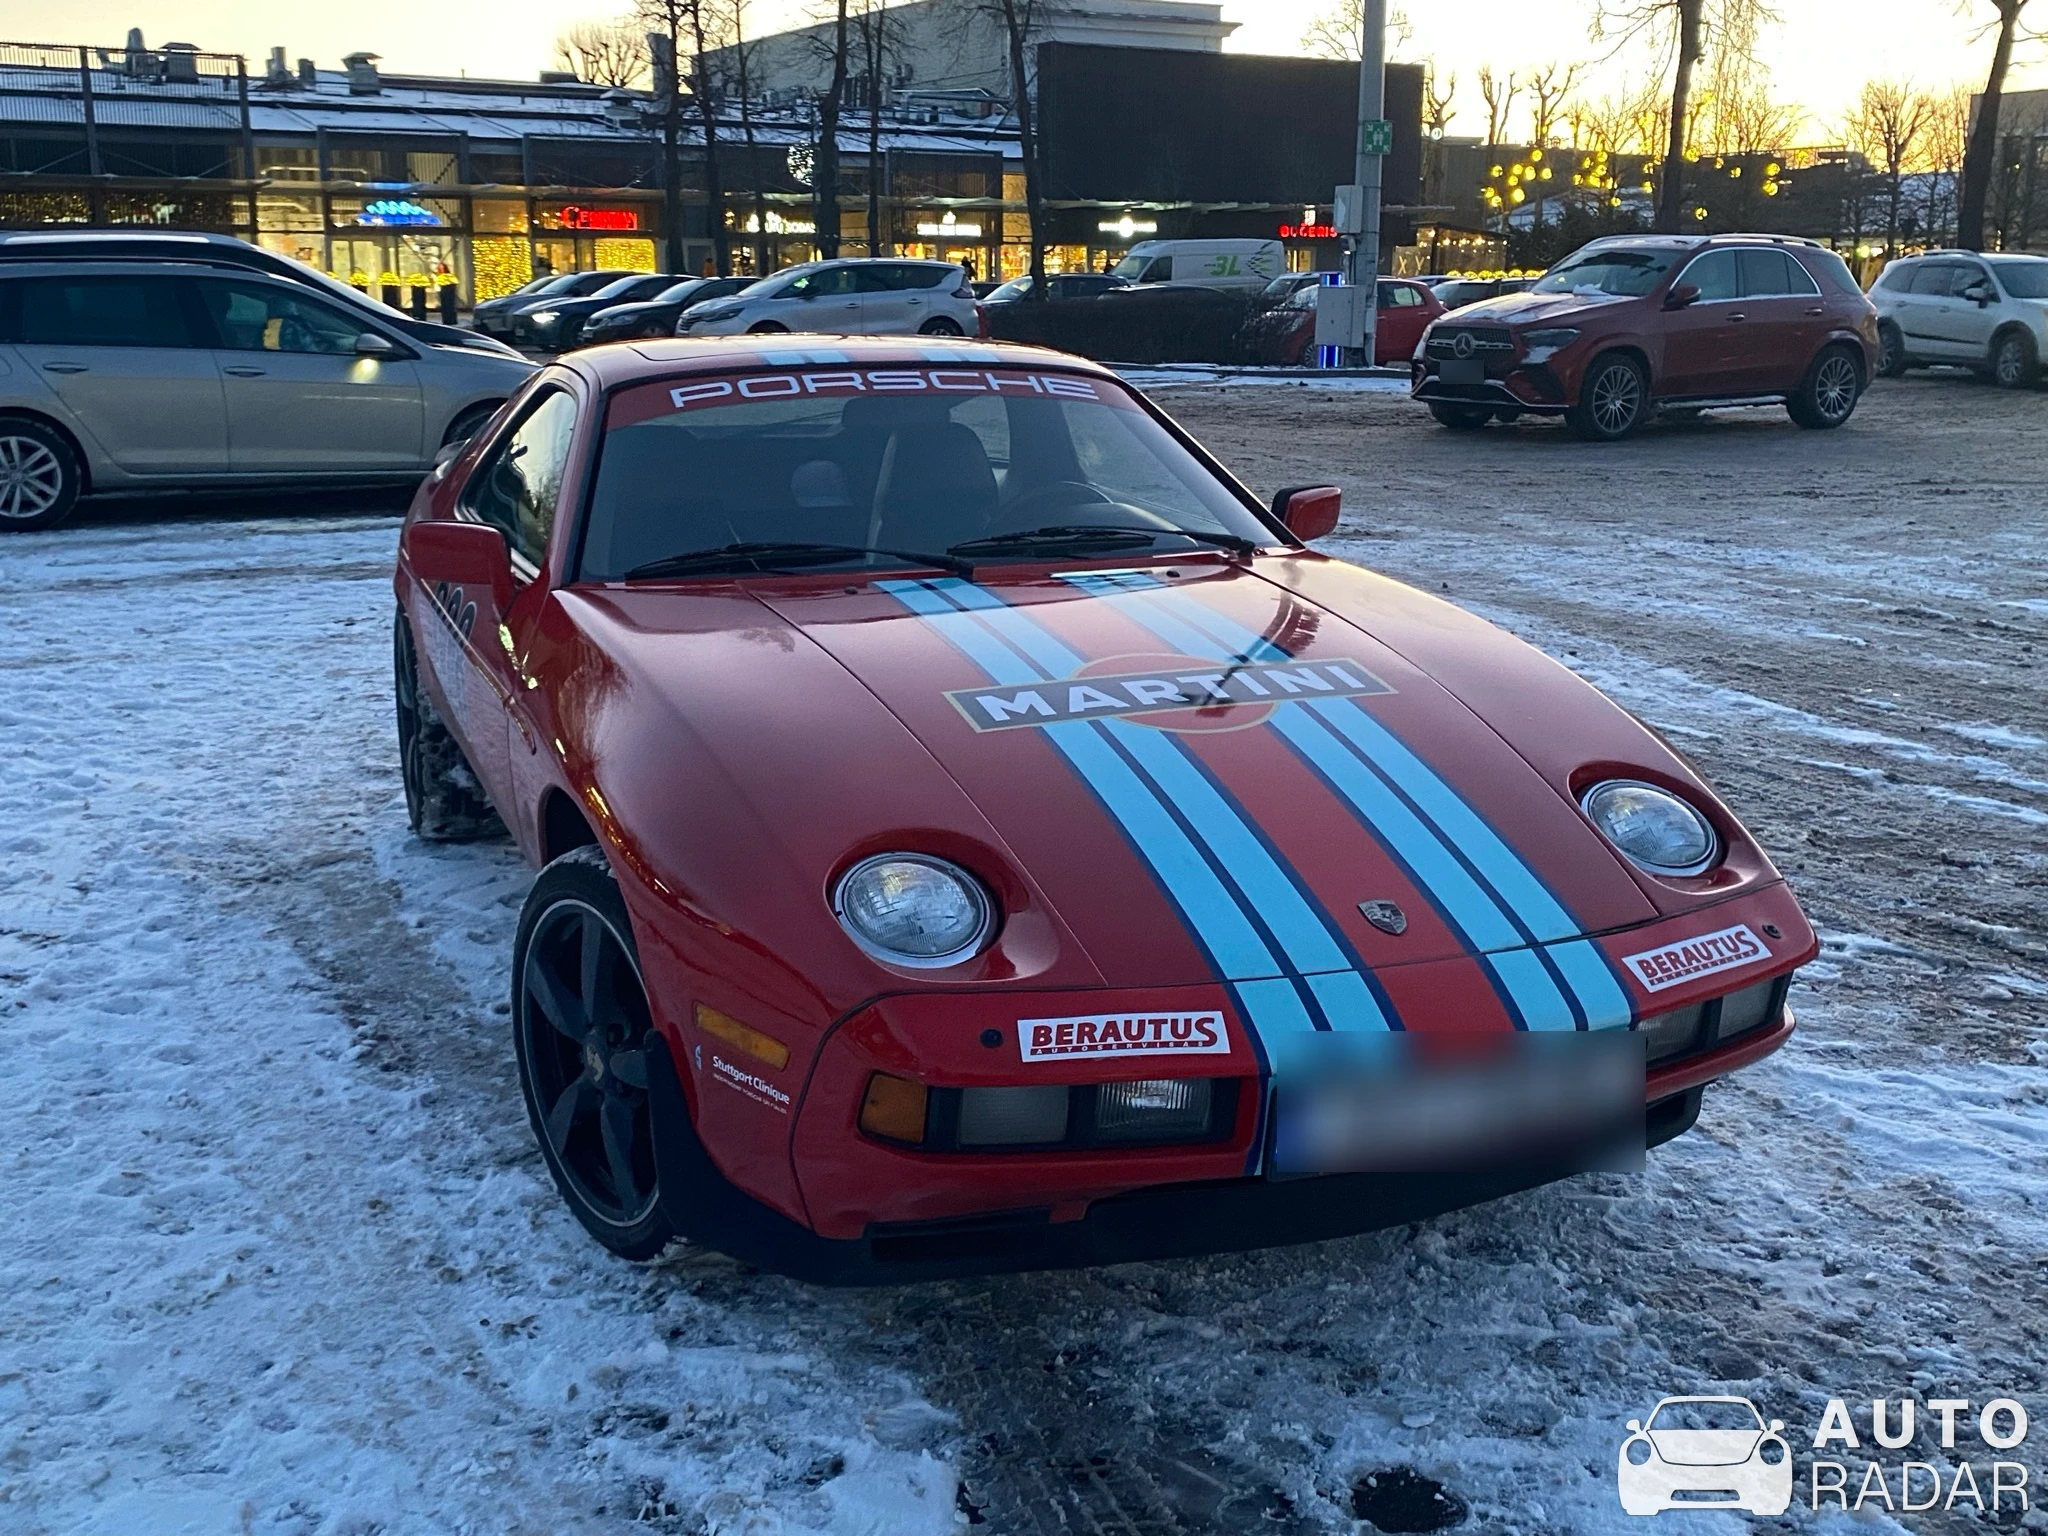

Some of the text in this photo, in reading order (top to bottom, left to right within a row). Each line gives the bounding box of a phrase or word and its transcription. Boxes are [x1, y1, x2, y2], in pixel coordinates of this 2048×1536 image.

[1210, 255, 1241, 276] 3L
[670, 371, 1099, 408] PORSCHE
[976, 665, 1367, 722] MARTINI
[1637, 930, 1760, 979] BERAUTUS
[1032, 1017, 1218, 1047] BERAUTUS
[1036, 1041, 1204, 1054] AUTOSERVISAS
[712, 1055, 752, 1086] Stuttgart
[753, 1077, 790, 1105] Clinique
